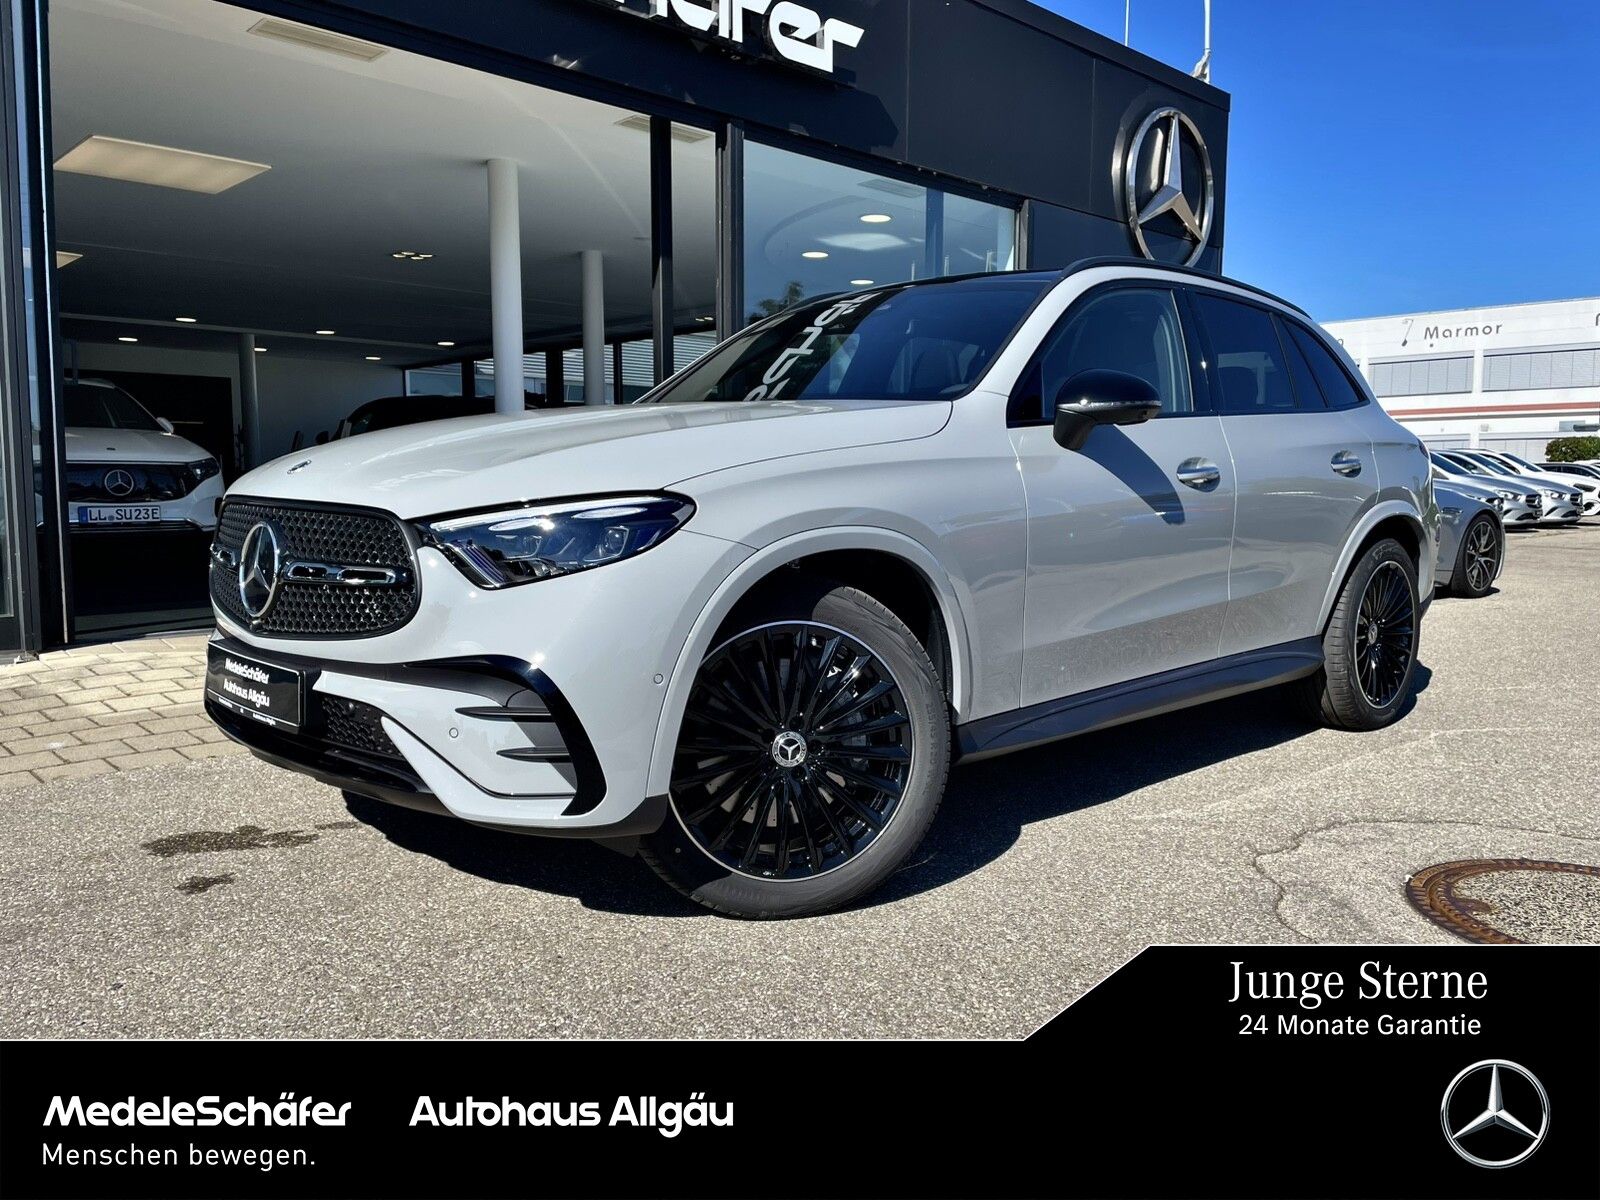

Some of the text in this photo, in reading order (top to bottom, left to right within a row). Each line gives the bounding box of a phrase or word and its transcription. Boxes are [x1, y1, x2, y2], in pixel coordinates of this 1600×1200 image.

[1424, 323, 1503, 340] Marmor
[223, 678, 248, 699] Autohaus
[247, 688, 270, 708] Allgäu
